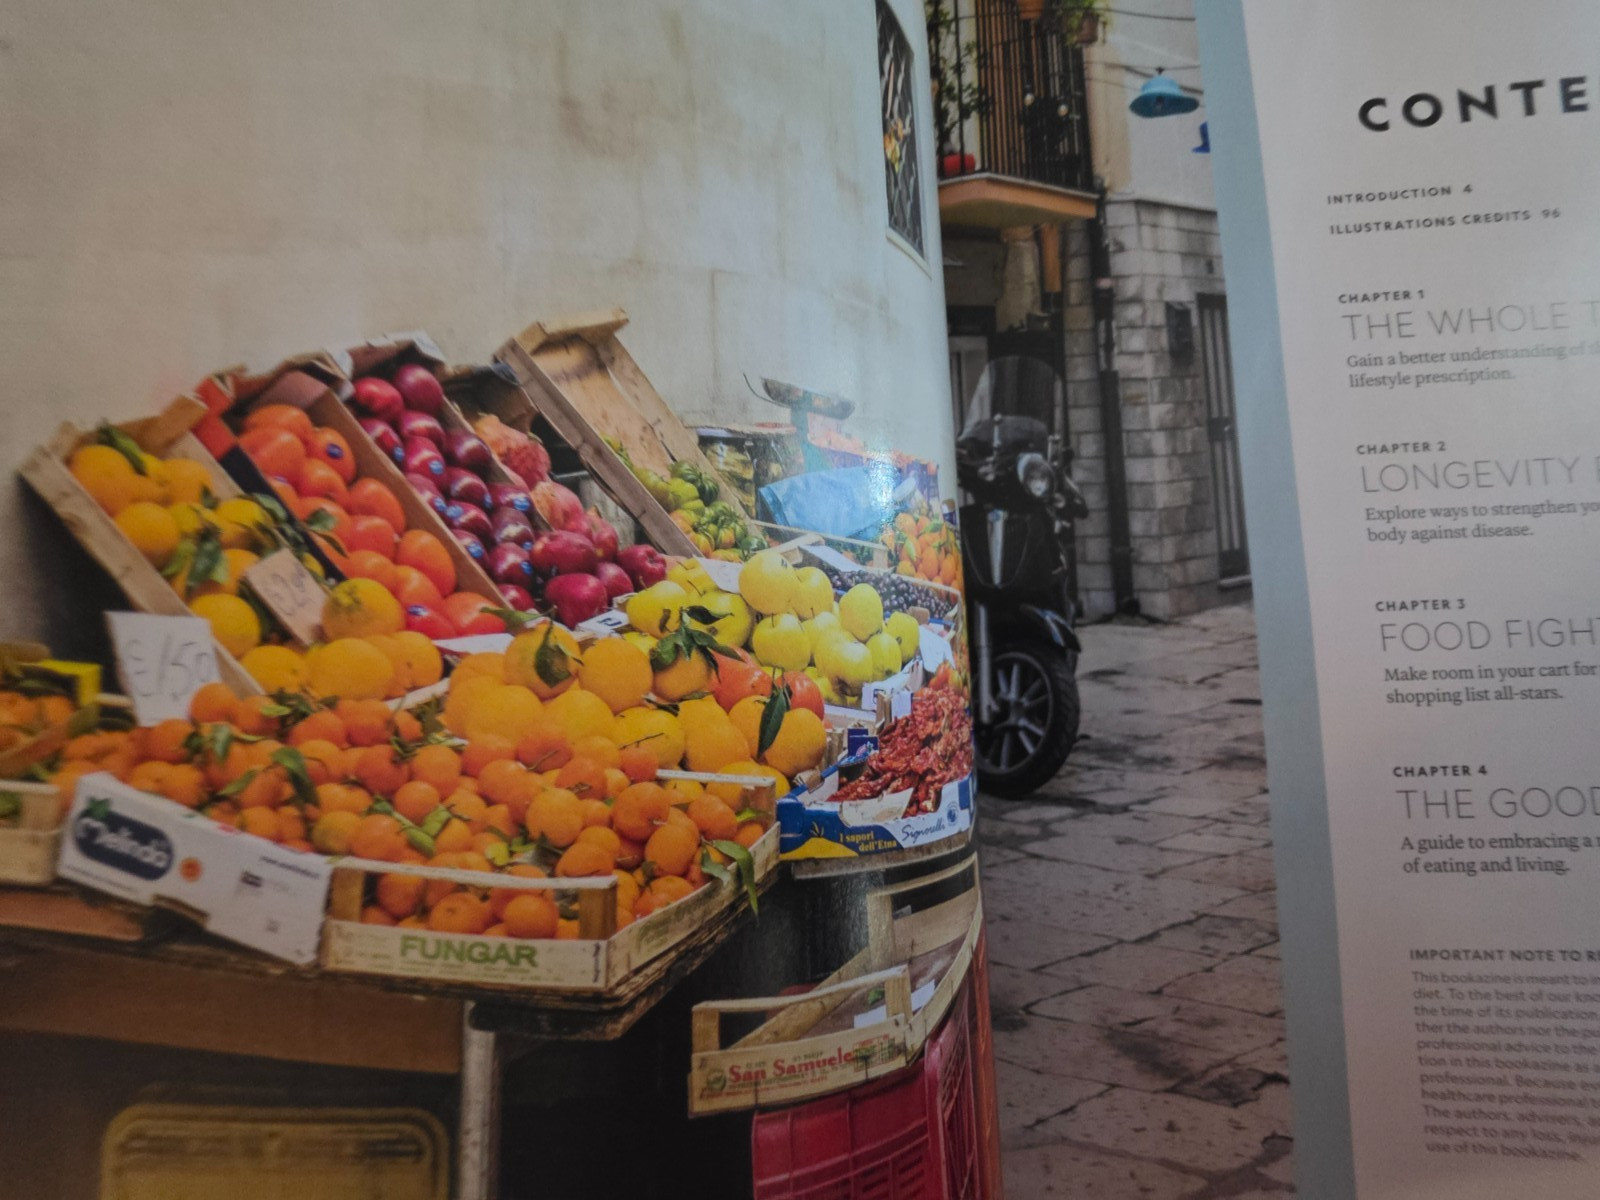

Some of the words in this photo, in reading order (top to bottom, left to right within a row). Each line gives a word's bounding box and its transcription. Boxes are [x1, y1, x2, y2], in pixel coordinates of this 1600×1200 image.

[1327, 185, 1453, 205] INTRODUCTION
[1463, 184, 1473, 194] 4
[1330, 215, 1455, 235] ILLUSTRATIONS
[1462, 210, 1531, 225] CREDITS
[1541, 208, 1561, 220] 96
[1338, 290, 1411, 304] CHAPTER
[1418, 290, 1425, 299] 1
[1341, 311, 1417, 340] THE
[1427, 302, 1571, 335] WHOLE
[1346, 354, 1384, 368] Gain
[1387, 356, 1396, 366] a
[1400, 351, 1446, 365] better
[1450, 343, 1567, 363] understanding
[1348, 371, 1411, 389] lifestyle
[1415, 367, 1515, 388] prescription.
[1356, 442, 1431, 455] CHAPTER
[1437, 441, 1446, 451] 2
[1361, 456, 1580, 493] LONGEVITY
[1365, 504, 1426, 524] Explore
[1430, 504, 1468, 521] ways
[1472, 504, 1488, 516] to
[1492, 500, 1576, 518] strengthen
[1367, 527, 1407, 544] body
[1411, 525, 1468, 544] against
[1472, 524, 1534, 538] disease.
[1375, 600, 1450, 612] CHAPTER
[1458, 598, 1466, 610] 3
[1380, 620, 1491, 651] FOOD
[1505, 617, 1600, 648] FIGH
[1384, 666, 1428, 682] Make
[1432, 667, 1474, 680] room
[1478, 665, 1494, 679] in
[1498, 665, 1535, 682] your
[1538, 664, 1570, 676] cart
[1574, 661, 1596, 676] for
[1386, 688, 1462, 706] shopping
[1465, 686, 1490, 701] list
[1494, 685, 1564, 700] all-stars.
[1393, 765, 1471, 778] CHAPTER
[1478, 765, 1488, 776] 4
[1395, 789, 1476, 819] THE
[845, 831, 875, 844] sapori
[858, 840, 898, 852] dell'Etna
[1401, 836, 1414, 850] A
[1418, 834, 1464, 854] guide
[1468, 836, 1485, 849] to
[1488, 833, 1580, 852] embracing
[1583, 838, 1592, 848] a
[1403, 858, 1421, 874] of
[1424, 858, 1477, 876] eating
[1480, 856, 1512, 872] and
[1516, 856, 1570, 876] living.
[401, 935, 538, 968] FUNGAR
[1410, 950, 1504, 961] IMPORTANT
[1510, 950, 1556, 962] NOTE
[1558, 950, 1582, 962] TO
[1412, 971, 1438, 984] This
[1441, 972, 1511, 984] bookazine
[1514, 974, 1524, 984] is
[1526, 975, 1571, 986] meant
[1572, 974, 1588, 986] to
[1448, 988, 1464, 1000] To
[1468, 989, 1492, 1000] the
[1495, 989, 1526, 1002] best
[1530, 989, 1543, 1002] of
[1547, 992, 1571, 1002] our
[1414, 1006, 1439, 1016] the
[1441, 1006, 1473, 1017] time
[1477, 1006, 1491, 1018] of
[1446, 1022, 1470, 1034] the
[1473, 1024, 1525, 1035] authors
[1416, 1038, 1501, 1052] professional
[728, 1065, 767, 1084] San
[773, 1046, 856, 1078] Samuele
[1450, 1056, 1463, 1067] in
[1464, 1056, 1491, 1068] this
